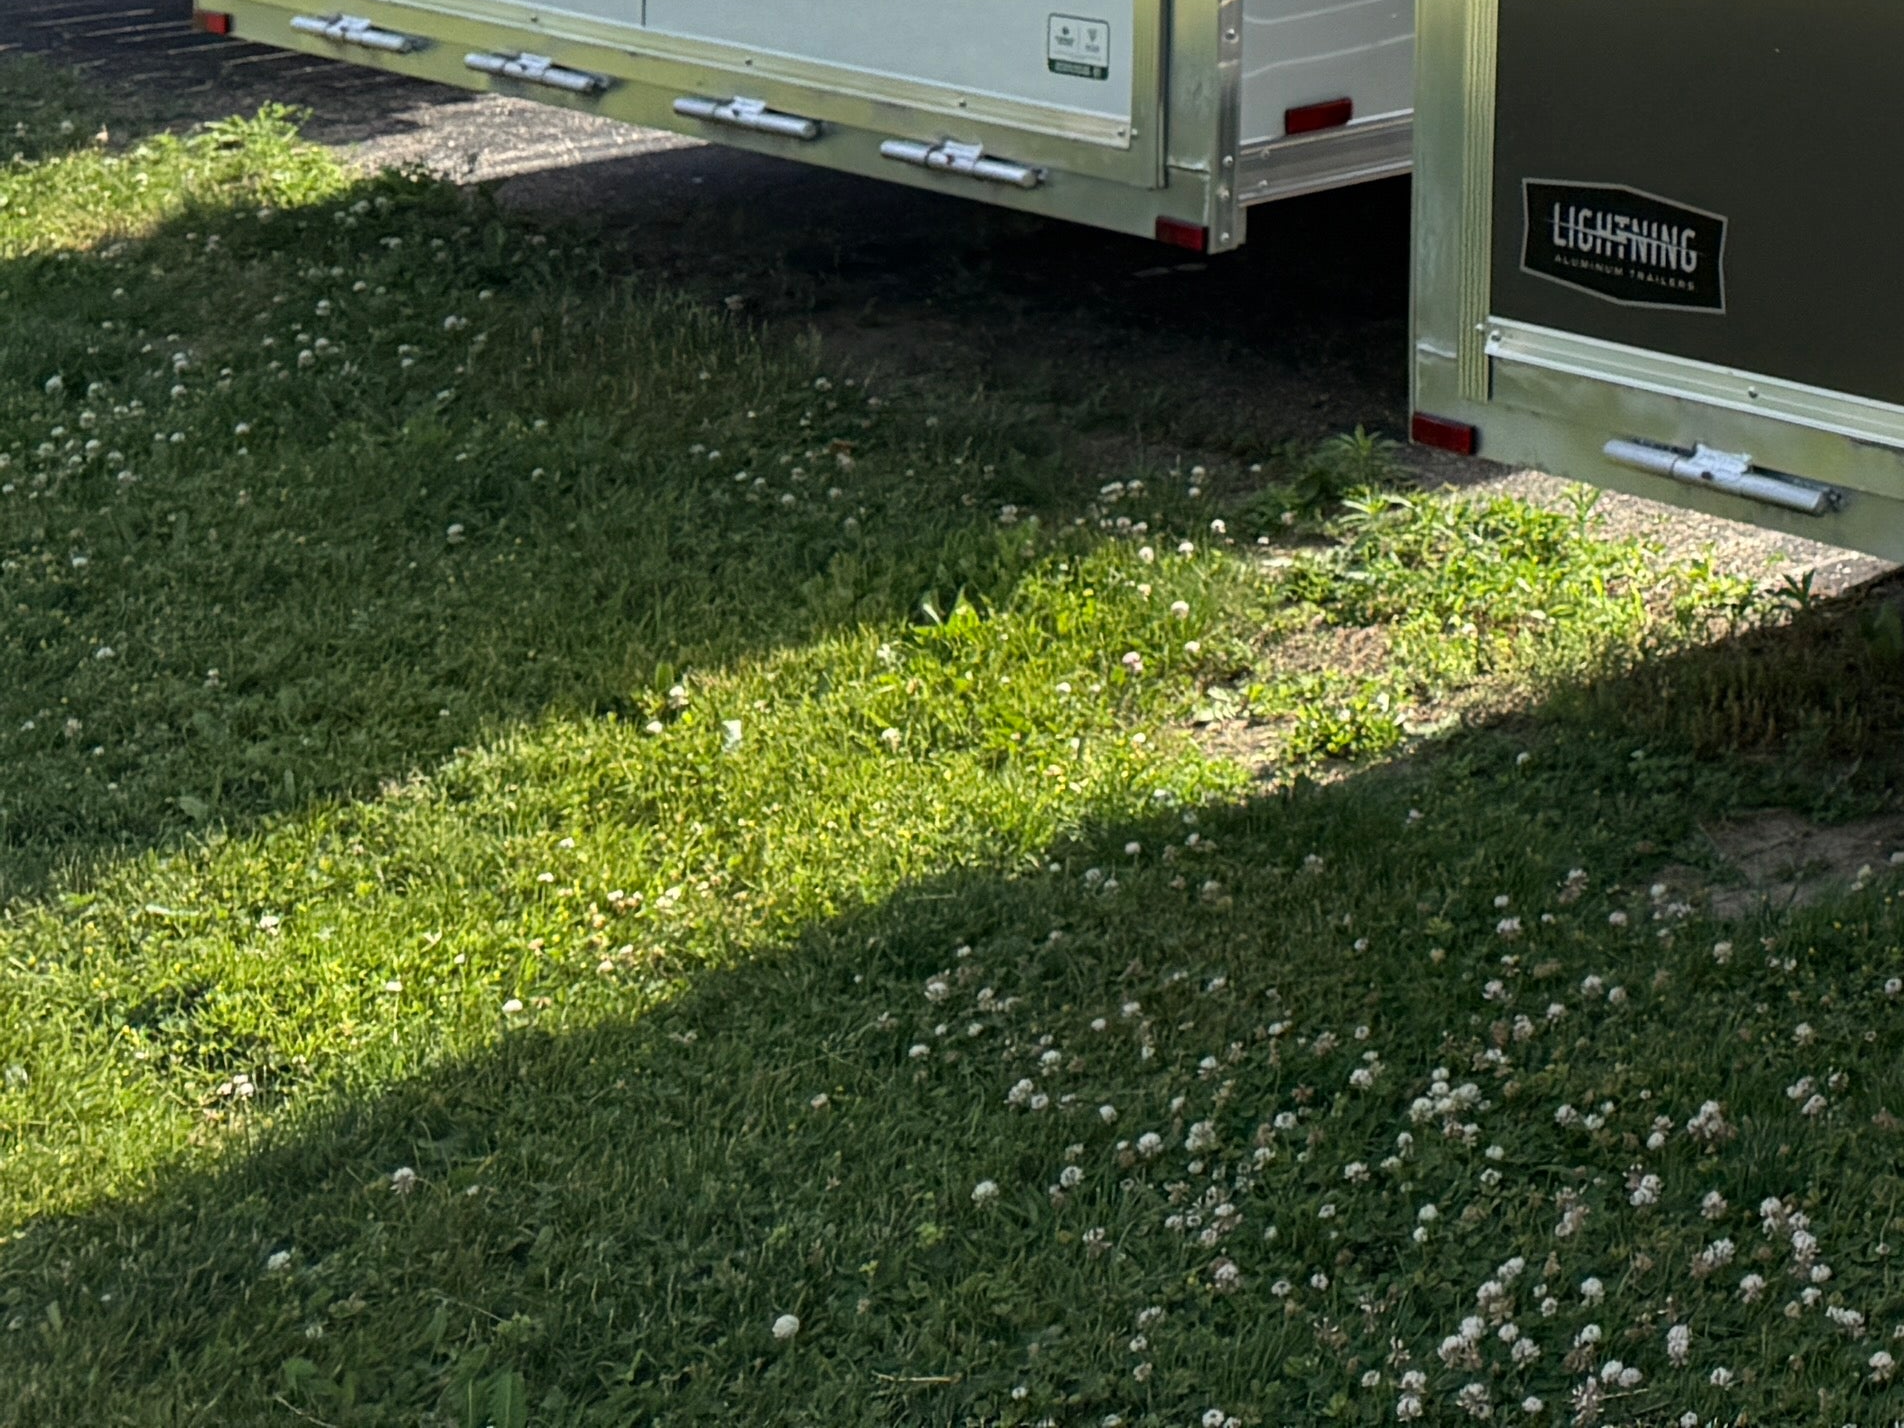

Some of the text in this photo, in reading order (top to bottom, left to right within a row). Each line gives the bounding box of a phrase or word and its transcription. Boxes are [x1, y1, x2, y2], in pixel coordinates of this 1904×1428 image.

[1553, 202, 1698, 273] LIGHTNING
[1554, 253, 1696, 292] ALUMINUM TRAILERS
